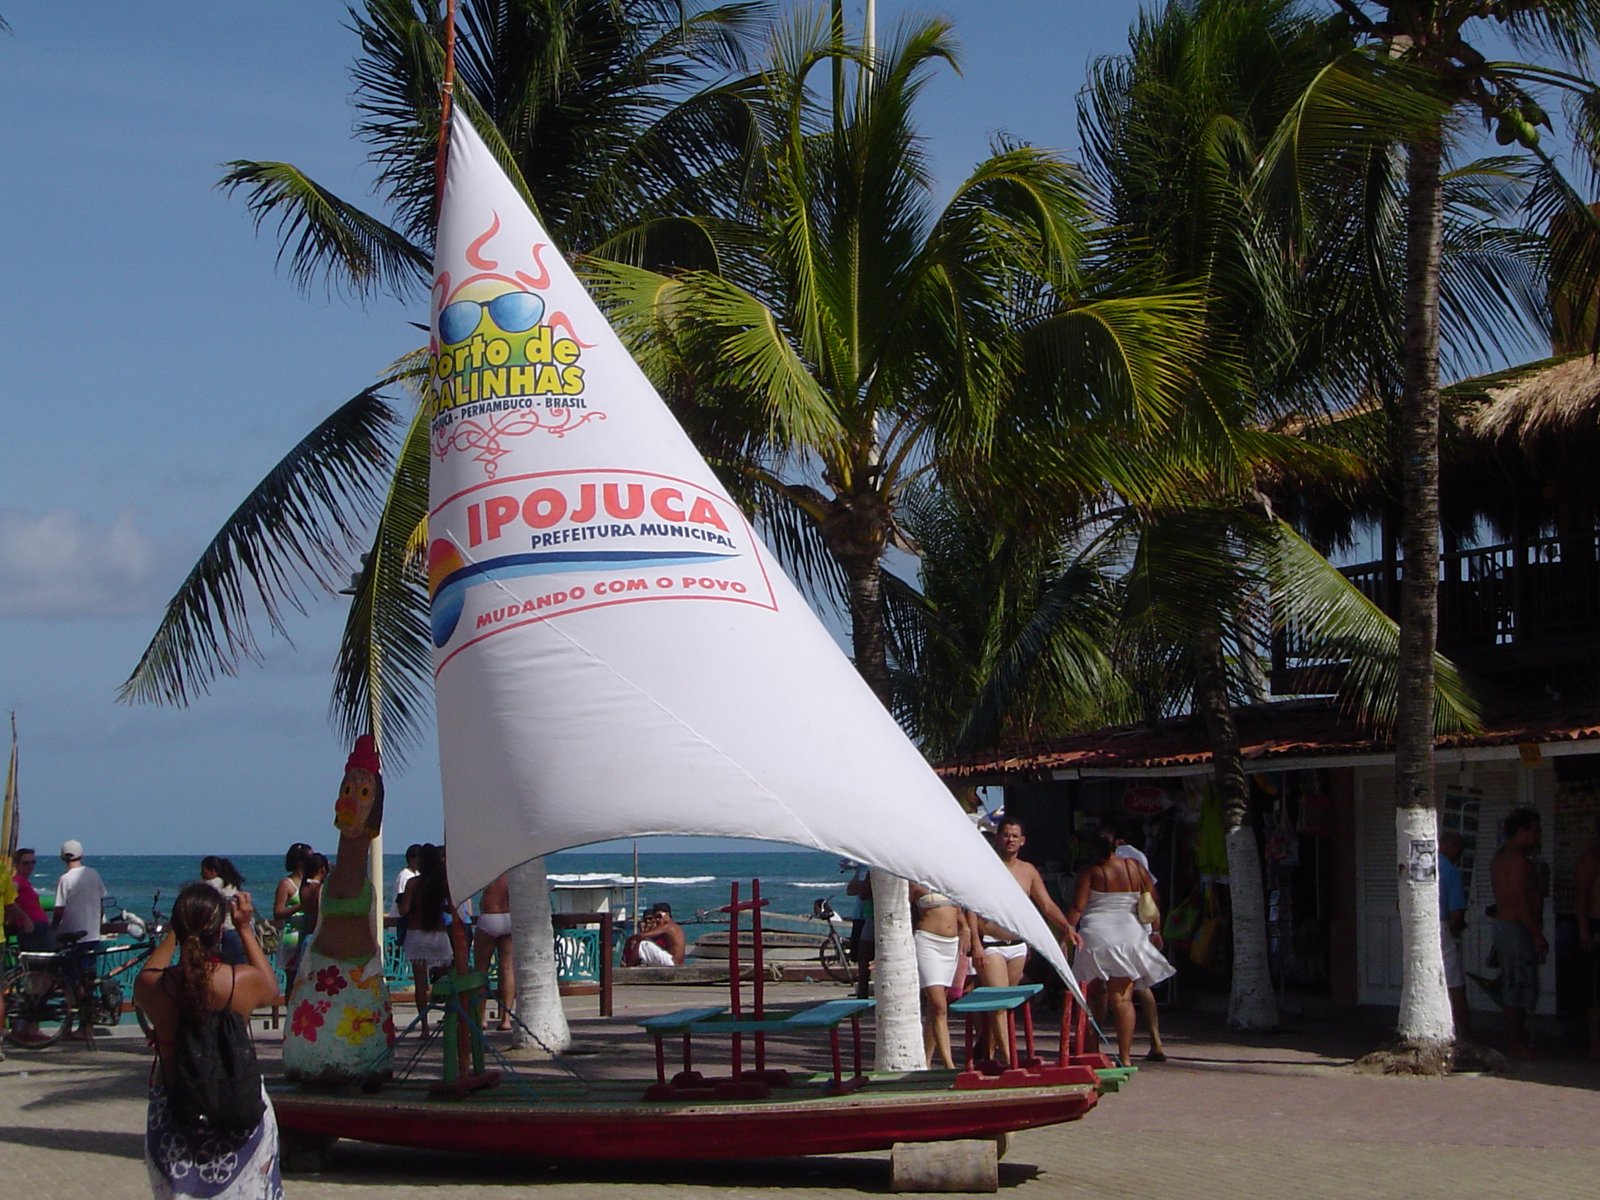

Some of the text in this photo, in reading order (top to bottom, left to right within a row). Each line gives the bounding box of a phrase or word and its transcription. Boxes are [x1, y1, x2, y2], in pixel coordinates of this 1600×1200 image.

[524, 326, 581, 365] de
[461, 398, 533, 420] PERNAMBUCO
[545, 397, 587, 409] BRASIL
[467, 483, 730, 548] IPOJUCA
[531, 523, 737, 549] PREFEITURA MUNICIPAL
[475, 577, 748, 629] MUDANDO COM O POVO
